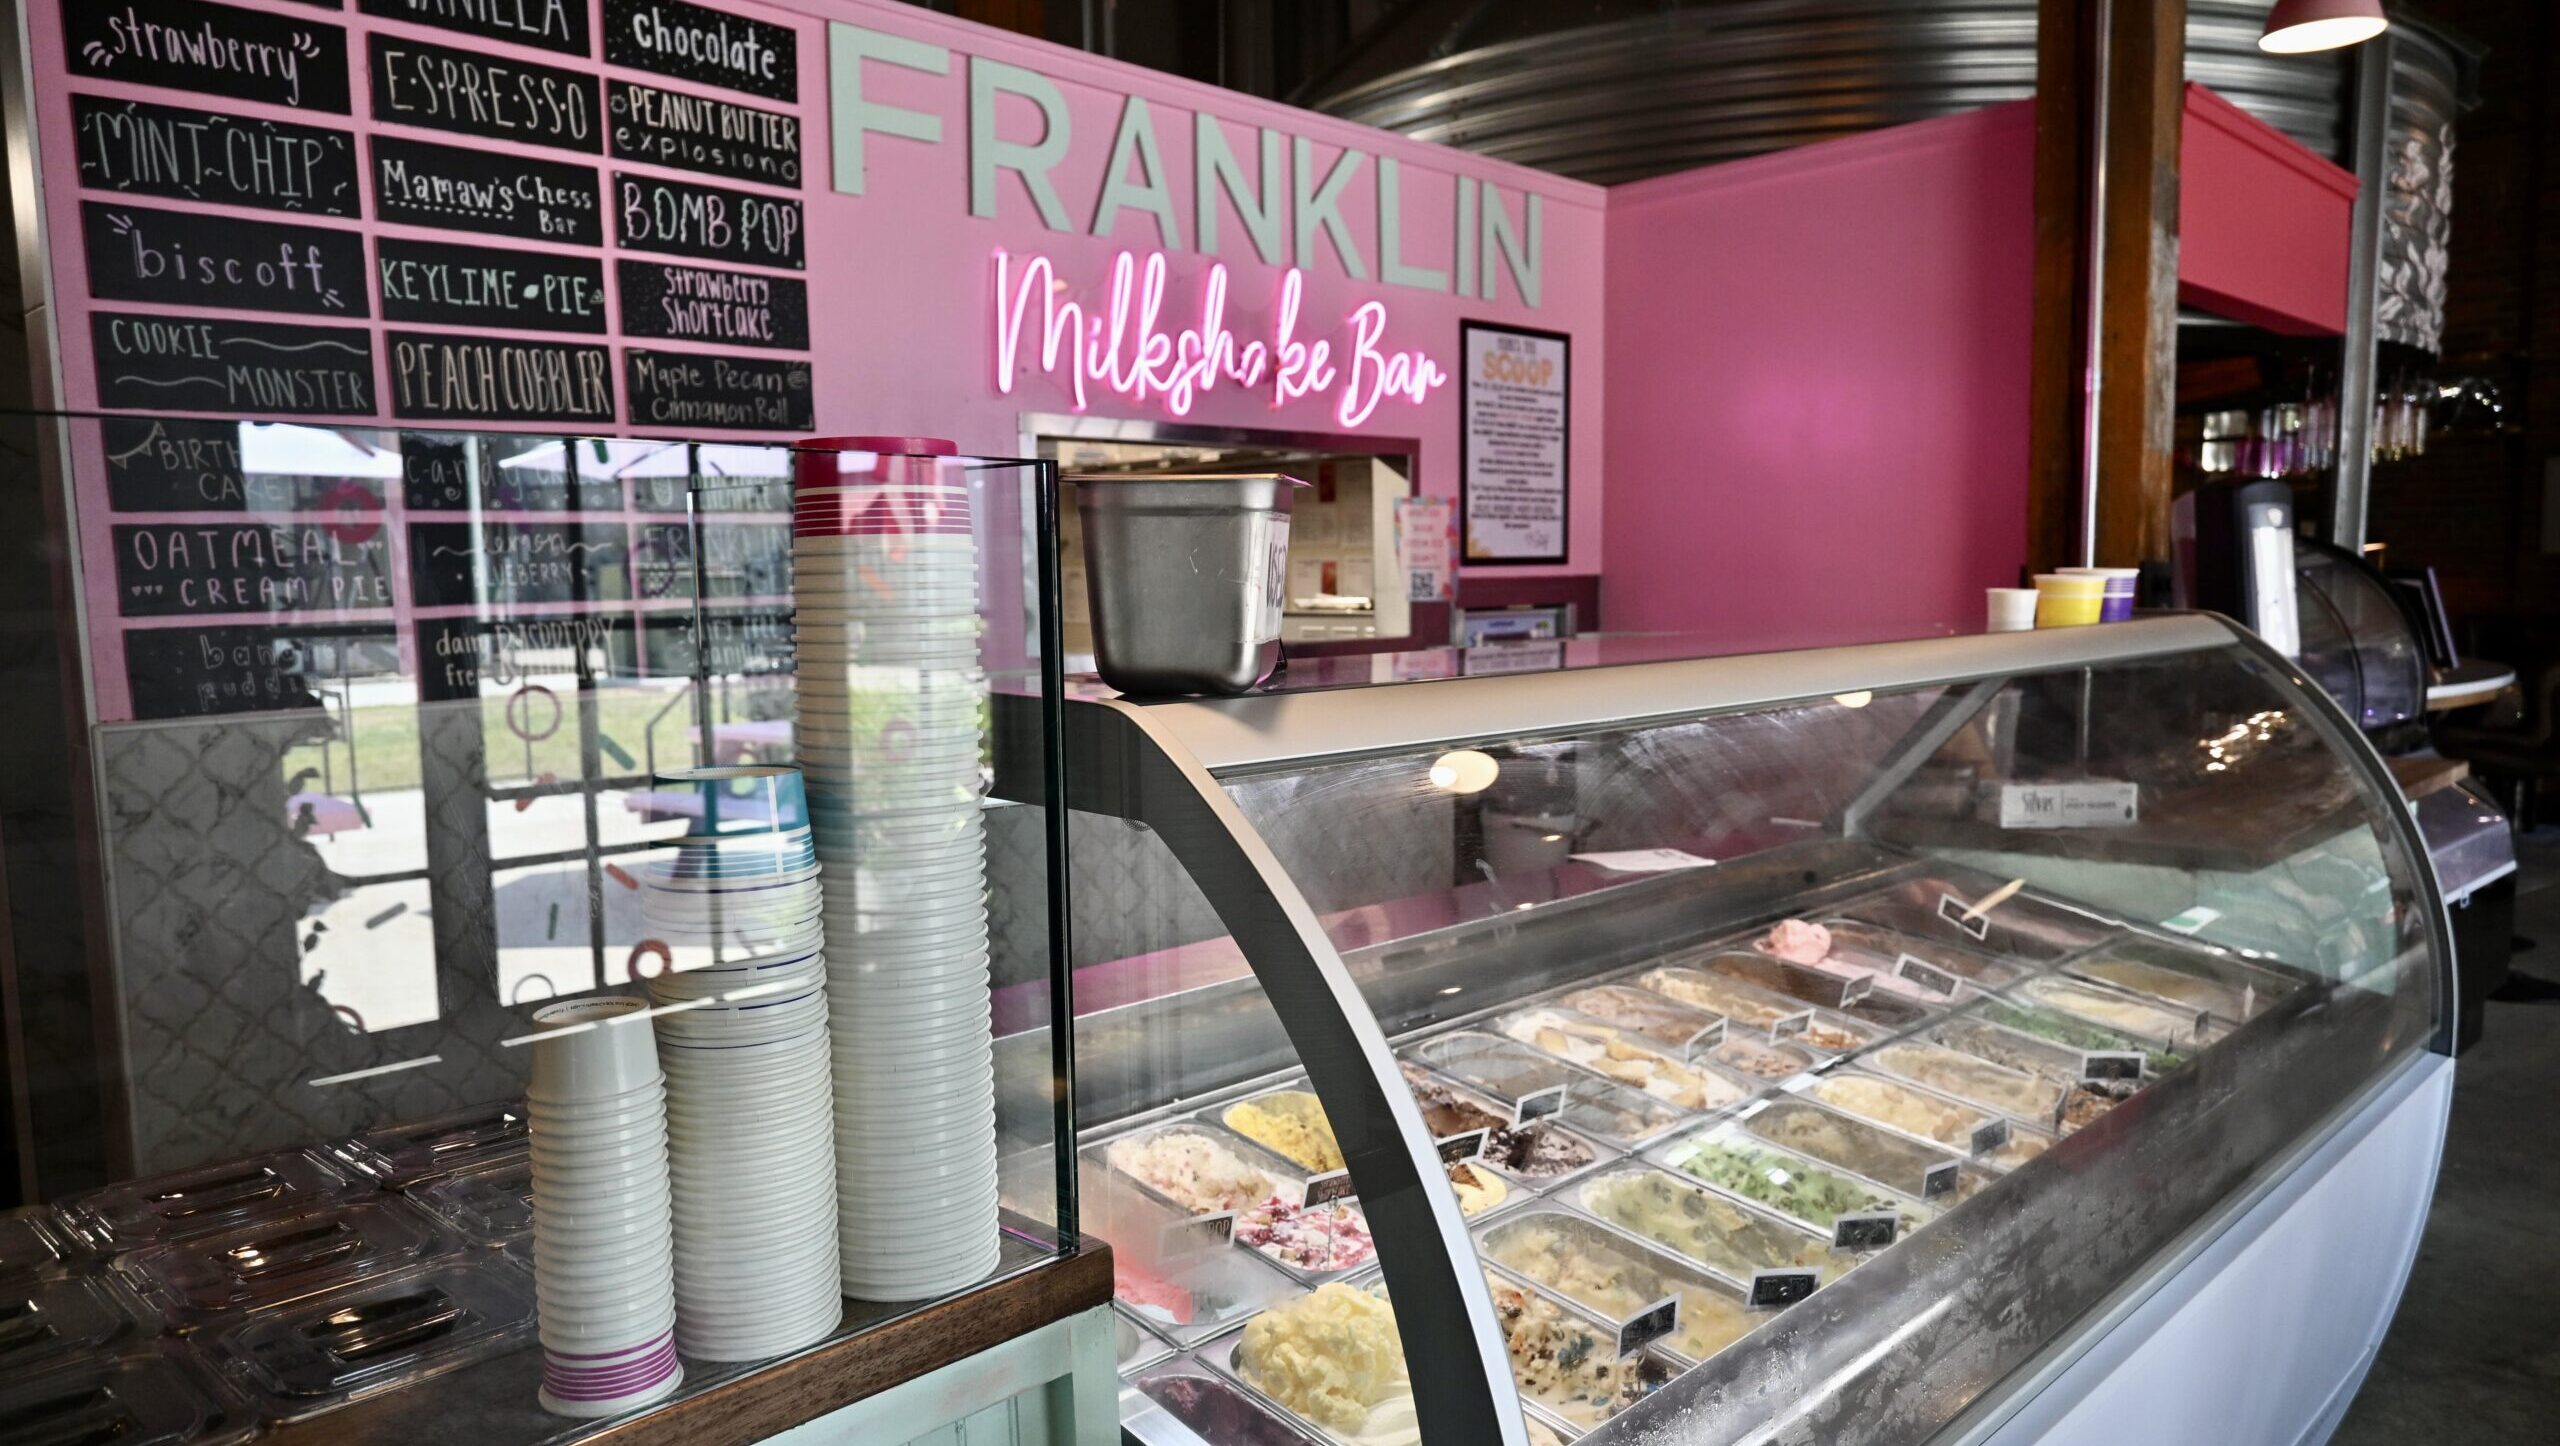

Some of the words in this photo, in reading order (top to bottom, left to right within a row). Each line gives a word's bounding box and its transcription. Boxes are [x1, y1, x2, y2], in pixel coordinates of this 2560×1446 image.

[109, 7, 300, 106] strawberry
[632, 12, 777, 81] chocolate
[628, 85, 715, 136] PEANUT
[720, 104, 798, 154] BUTTER
[96, 111, 209, 185] MINT
[225, 127, 324, 199] CHIP
[615, 126, 778, 175] explosion
[828, 19, 1543, 309] FRANKLIN
[382, 158, 515, 213] Mamaw's
[515, 174, 593, 210] Chess
[538, 208, 578, 235] Bar
[624, 181, 732, 249] BOMB
[741, 198, 799, 256] POP
[133, 229, 324, 293] biscoff
[379, 258, 519, 309] KEYLIME
[543, 274, 591, 316] PIE
[111, 319, 220, 360] COOKIE
[996, 248, 1336, 416] Milkshake
[1338, 300, 1447, 429] Bar
[227, 365, 369, 409] MONSTER
[396, 341, 498, 413] PEACH
[500, 346, 612, 415] COBBLER
[636, 357, 703, 398] Maple
[714, 359, 783, 393] Pecan
[134, 529, 357, 571] OATMEAL
[181, 577, 309, 608] CREAM
[332, 576, 390, 601] PIE
